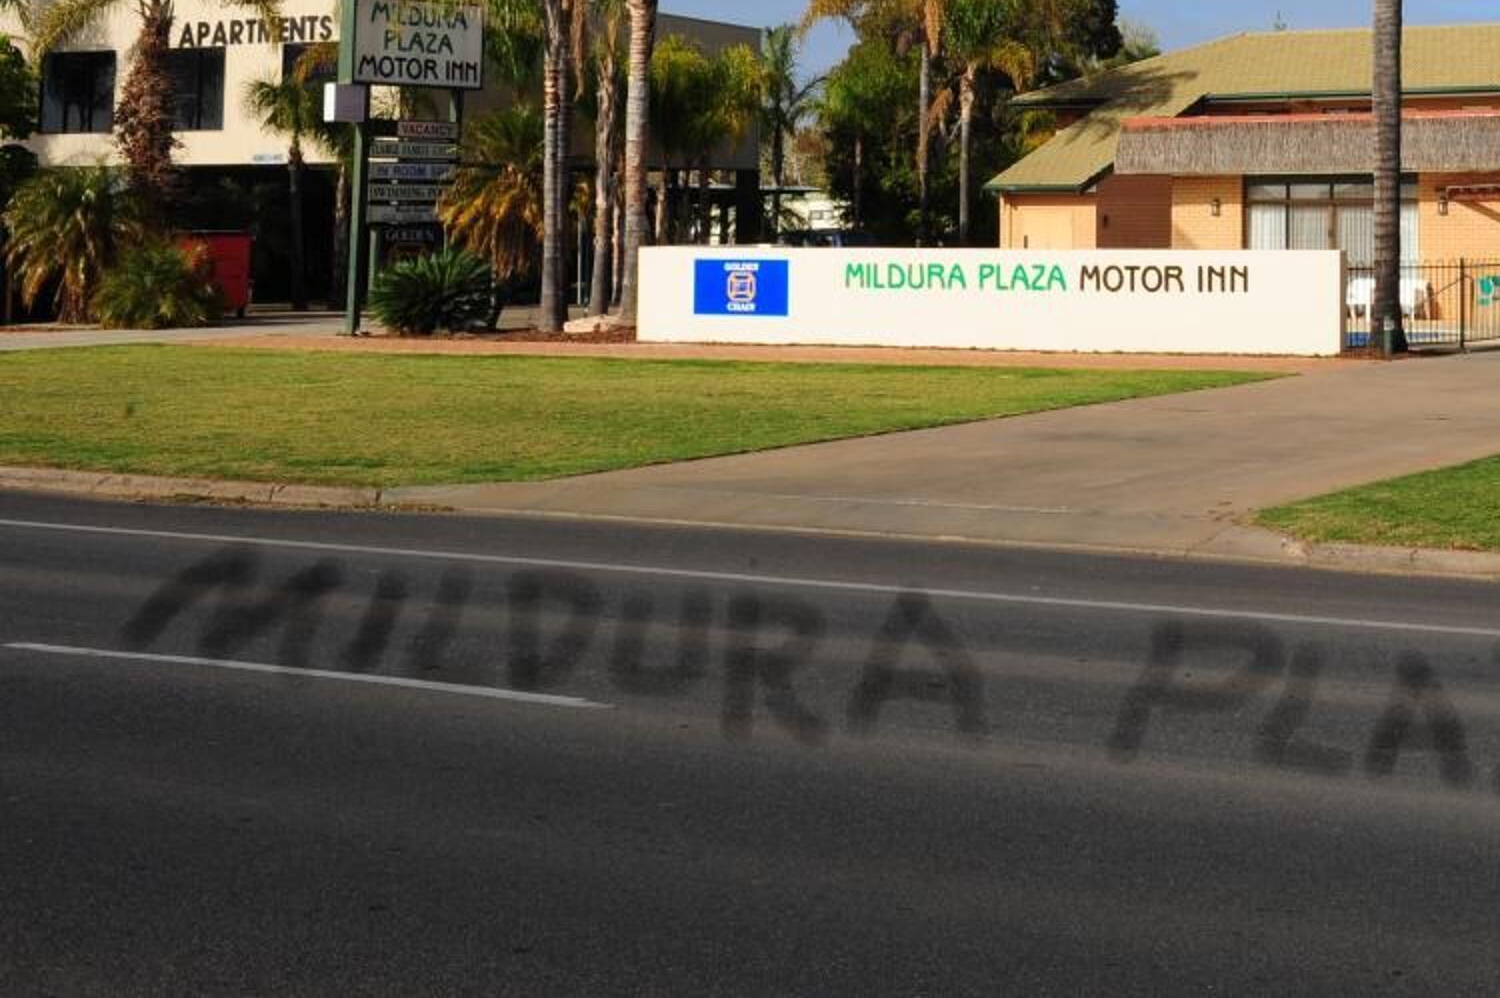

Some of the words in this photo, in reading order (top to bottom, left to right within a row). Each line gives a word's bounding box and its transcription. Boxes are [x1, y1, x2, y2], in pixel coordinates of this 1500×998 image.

[179, 16, 332, 48] APARTMENTS
[384, 32, 453, 55] PLAZA
[358, 56, 438, 79] MOTOR
[446, 60, 478, 83] INN
[402, 123, 453, 136] VACANCY
[393, 166, 426, 177] ROOM
[845, 263, 967, 290] MILDURA
[978, 263, 1067, 291] PLAZA
[1080, 264, 1185, 292] MOTOR
[1197, 265, 1249, 292] INN
[120, 547, 988, 746] MILDURA
